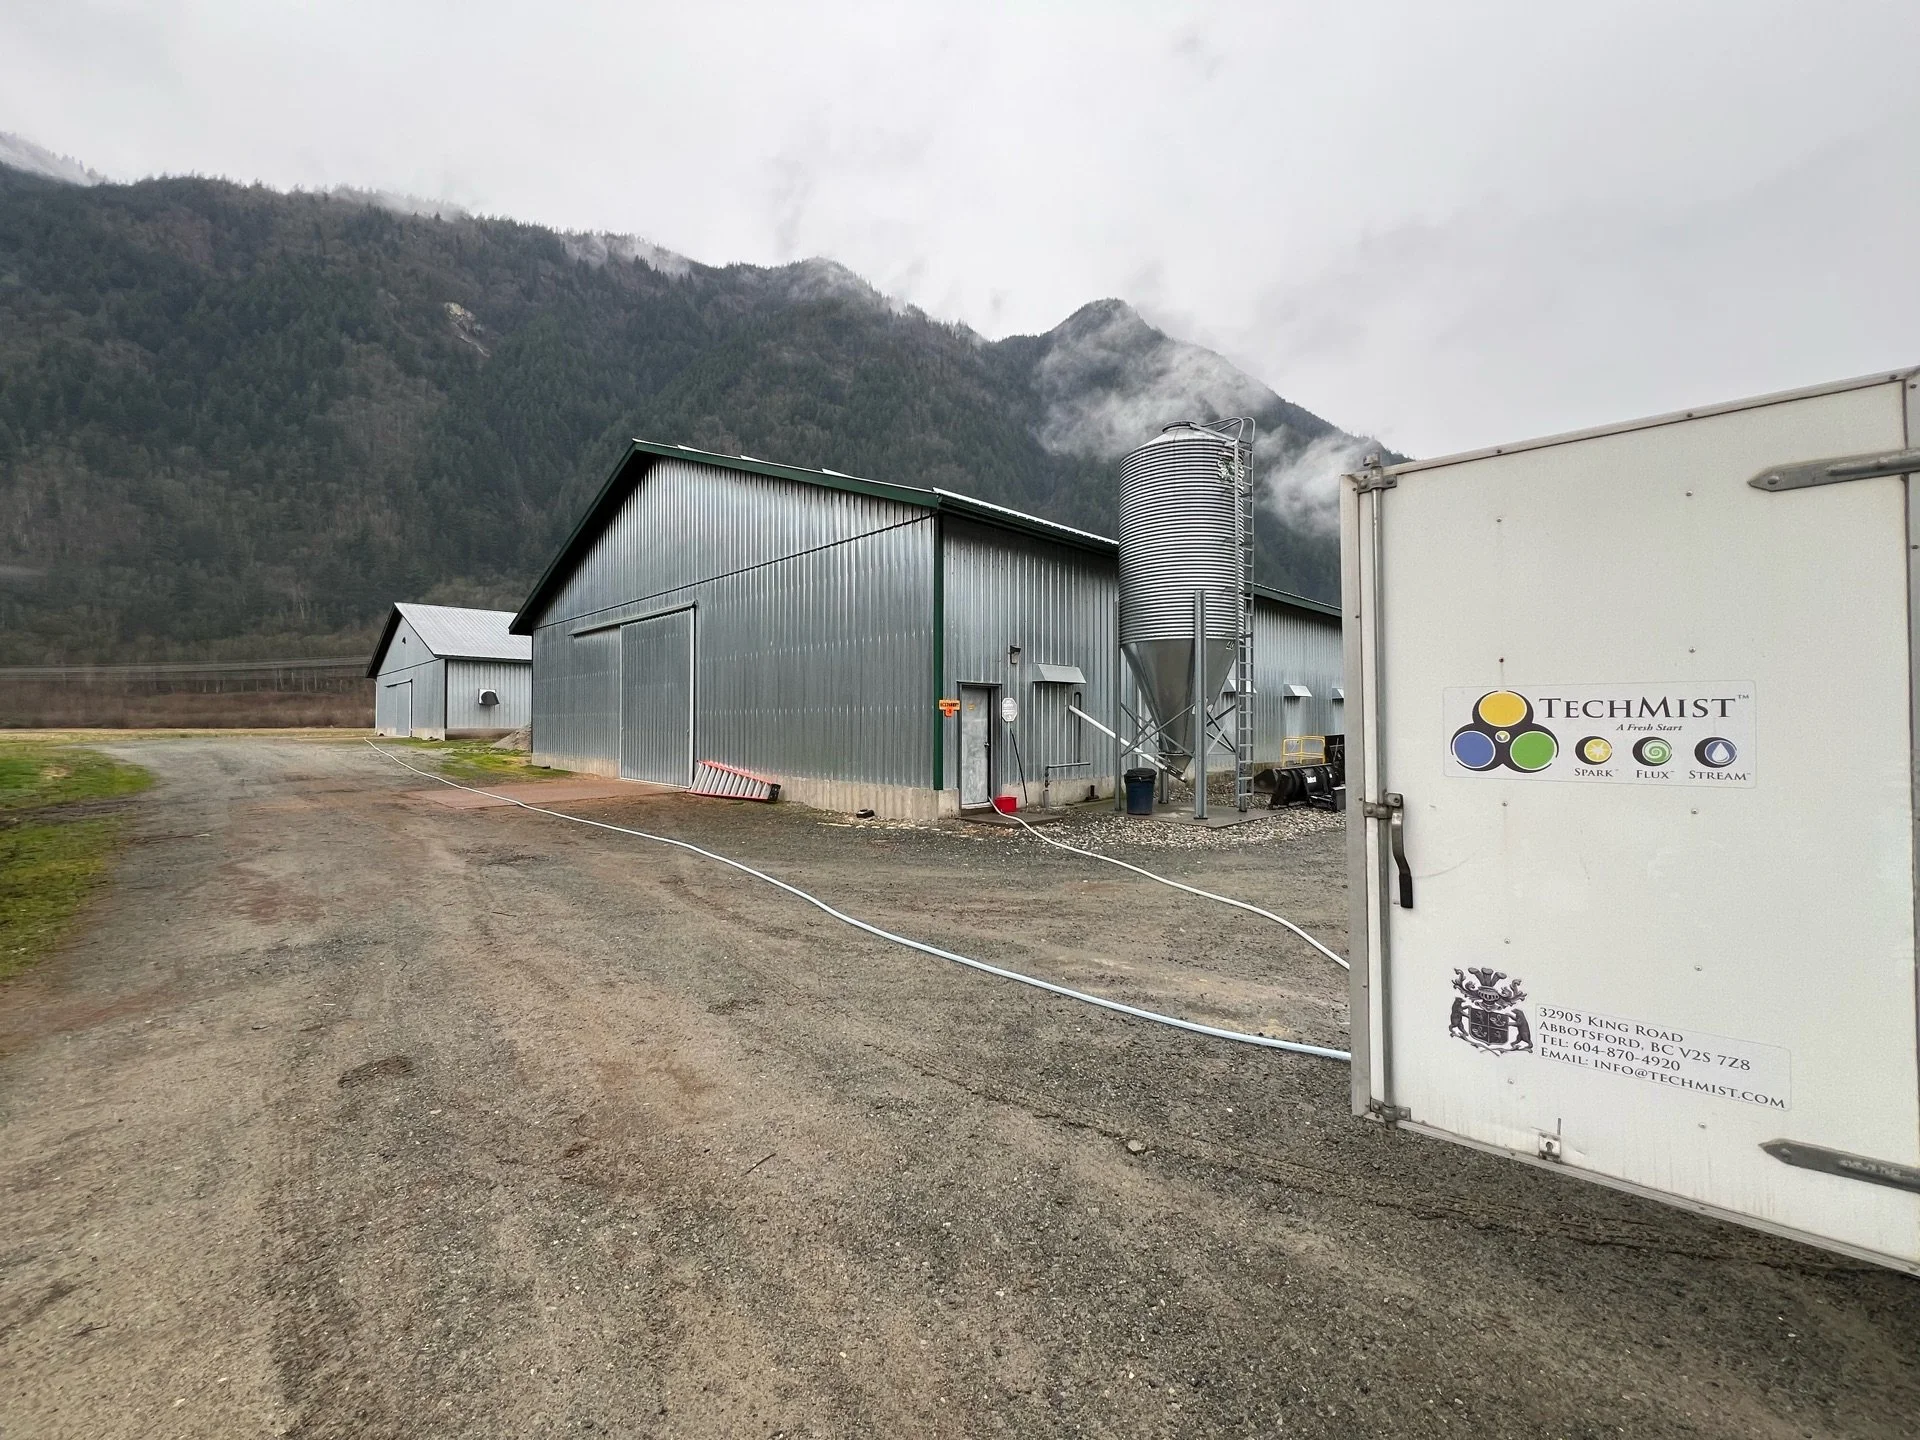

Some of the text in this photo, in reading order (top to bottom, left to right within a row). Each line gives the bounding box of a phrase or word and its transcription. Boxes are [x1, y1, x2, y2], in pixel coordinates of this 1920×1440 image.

[1627, 723, 1653, 731] Fresh
[1574, 768, 1614, 777] SPARK
[1539, 1007, 1684, 1043] 32905 KING ROAD
[1573, 1041, 1681, 1071] 604-870-4920
[1651, 1041, 1674, 1056] BC
[1679, 1047, 1711, 1063] V2S
[1717, 1054, 1751, 1071] 7Z8
